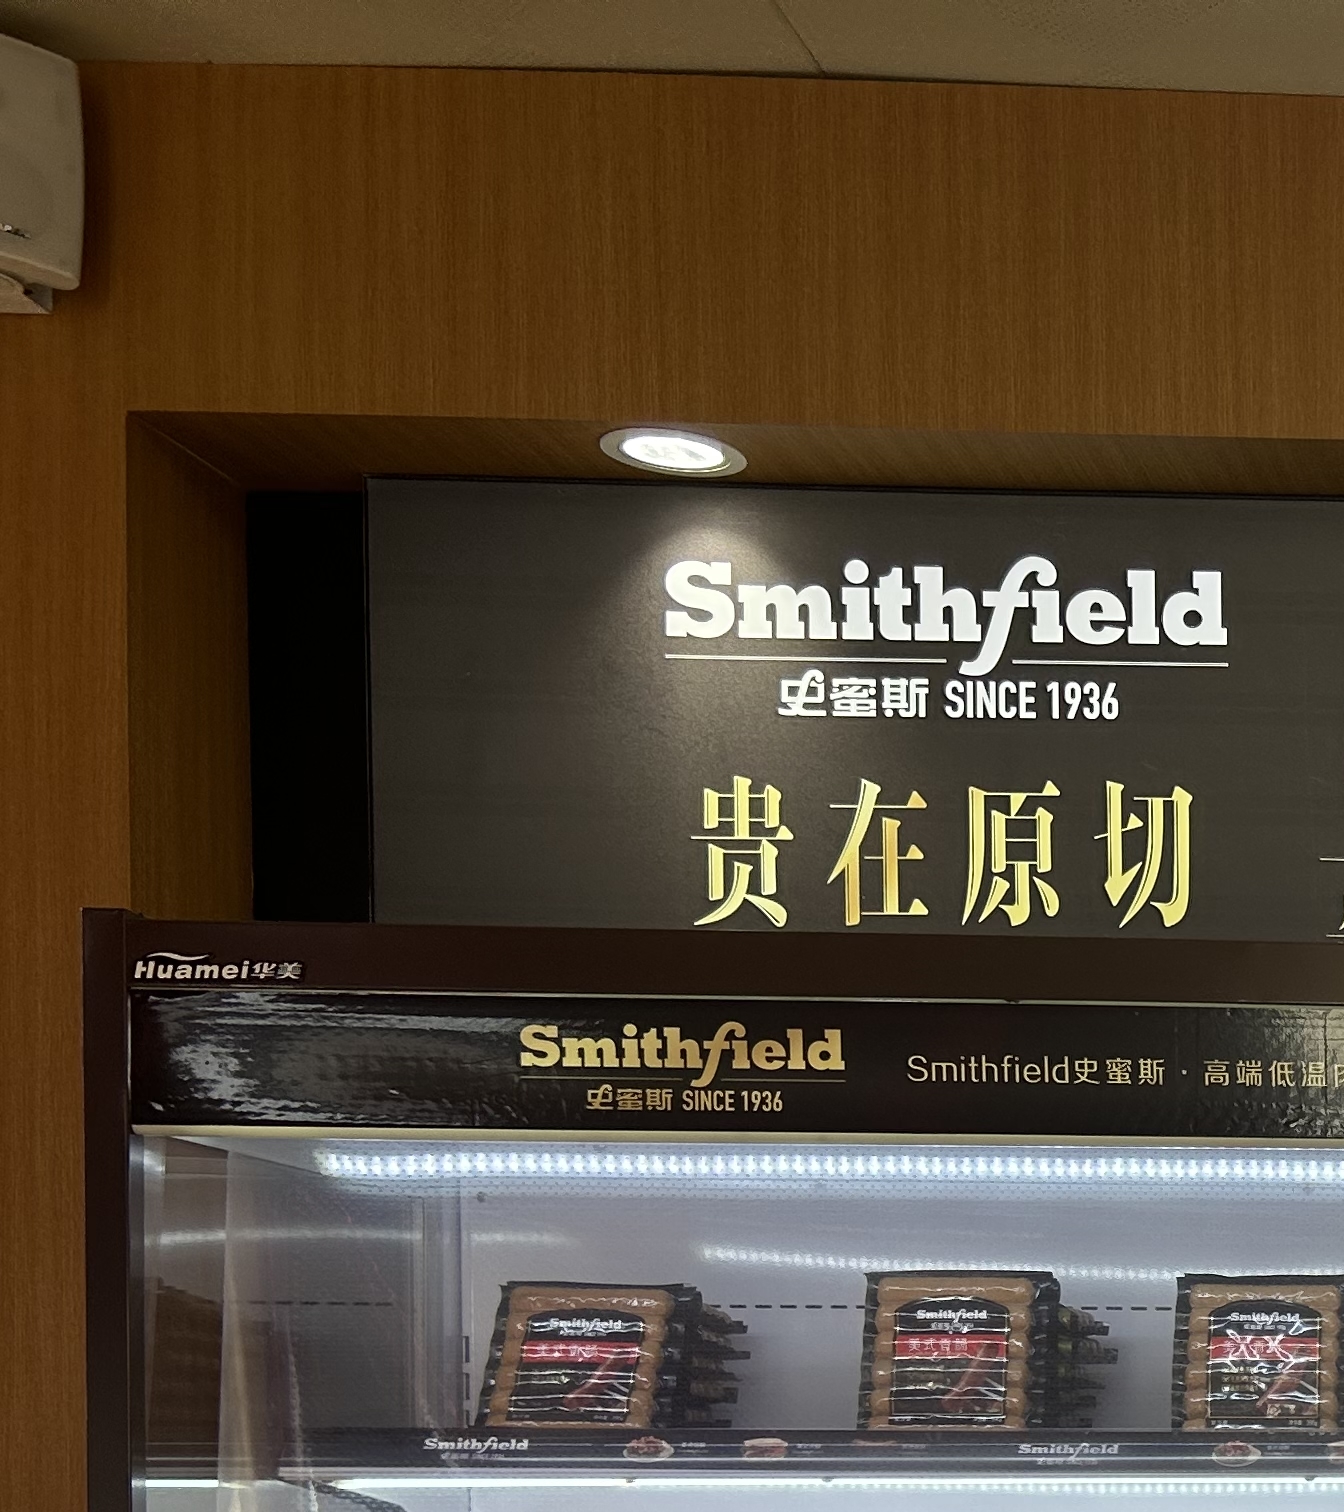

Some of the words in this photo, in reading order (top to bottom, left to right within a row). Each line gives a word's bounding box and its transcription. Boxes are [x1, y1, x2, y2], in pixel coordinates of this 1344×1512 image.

[664, 556, 1228, 676] Smithfield
[779, 670, 929, 718] 史蜜斯
[944, 681, 1037, 719] SINCE
[1046, 681, 1119, 720] 1936
[690, 776, 1192, 929] 贵在原切
[519, 1021, 846, 1087] Smithfield
[586, 1083, 674, 1112] 史蜜斯
[682, 1088, 736, 1112] SINCE
[742, 1089, 784, 1113] 1936
[916, 1309, 988, 1324] Smithfield
[423, 1437, 528, 1453] Smithfield
[1018, 1443, 1119, 1460] Smithfield
